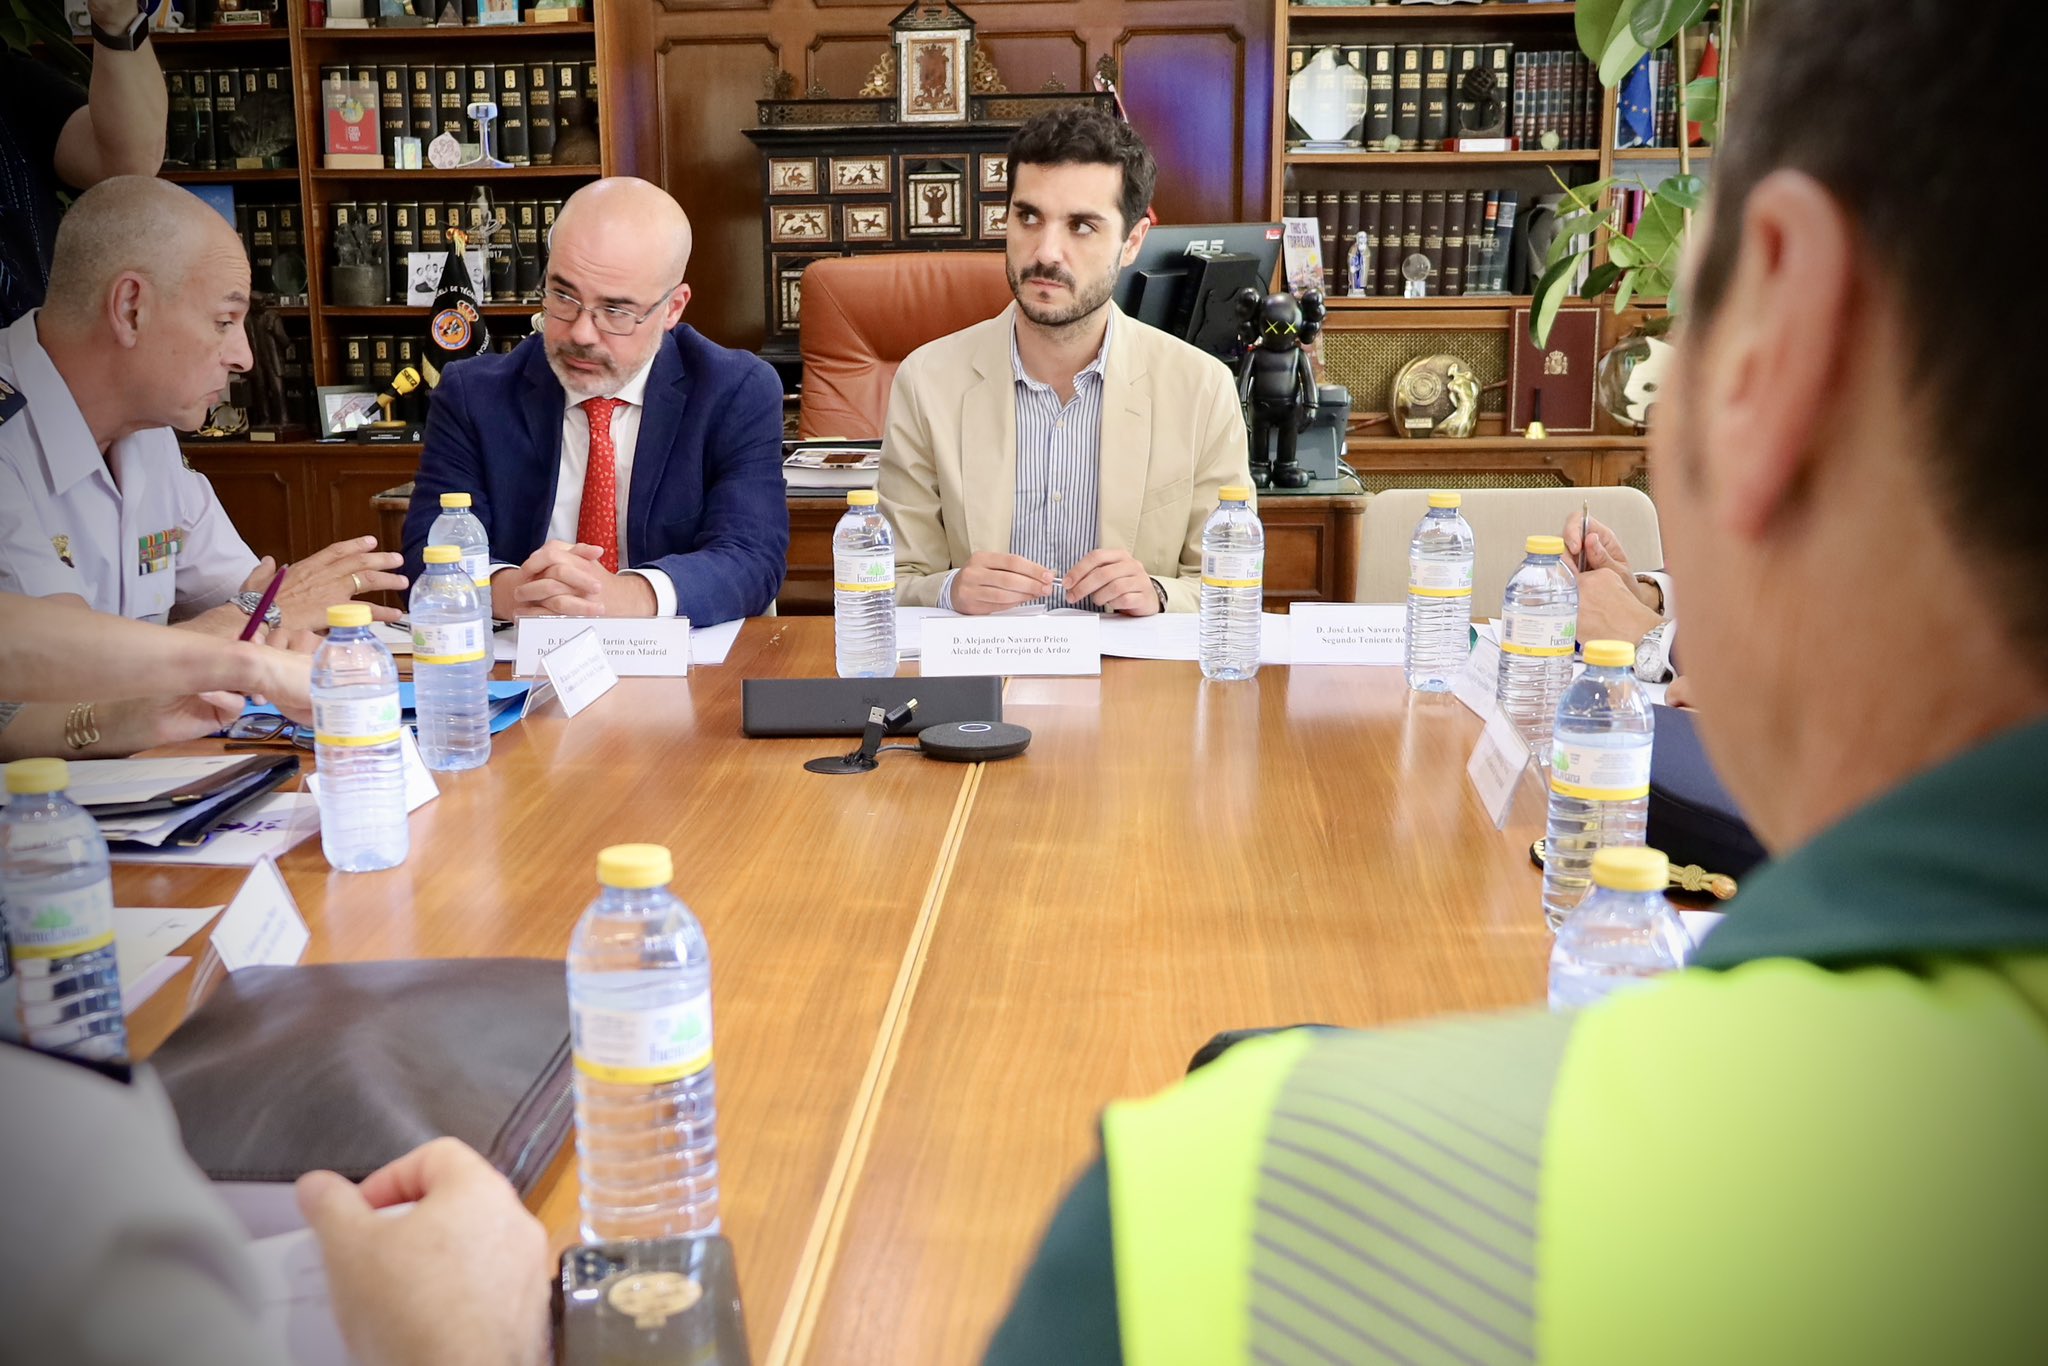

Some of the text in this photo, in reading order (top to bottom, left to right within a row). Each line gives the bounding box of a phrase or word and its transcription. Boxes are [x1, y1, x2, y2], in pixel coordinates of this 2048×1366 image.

[1183, 239, 1224, 257] ASUS
[1316, 625, 1326, 634] D.
[1328, 625, 1345, 634] José
[1347, 625, 1365, 634] Luis
[1367, 625, 1401, 634] Navarro
[547, 638, 557, 646] D.
[627, 637, 658, 647] Aguirre
[953, 635, 1069, 646] D. Alejandro Navarro Prieto
[1321, 636, 1357, 646] Segundo
[1359, 636, 1393, 644] Teniente
[637, 647, 667, 656] Madrid
[951, 646, 1071, 656] Alcalde de Torrejón de Ardoz
